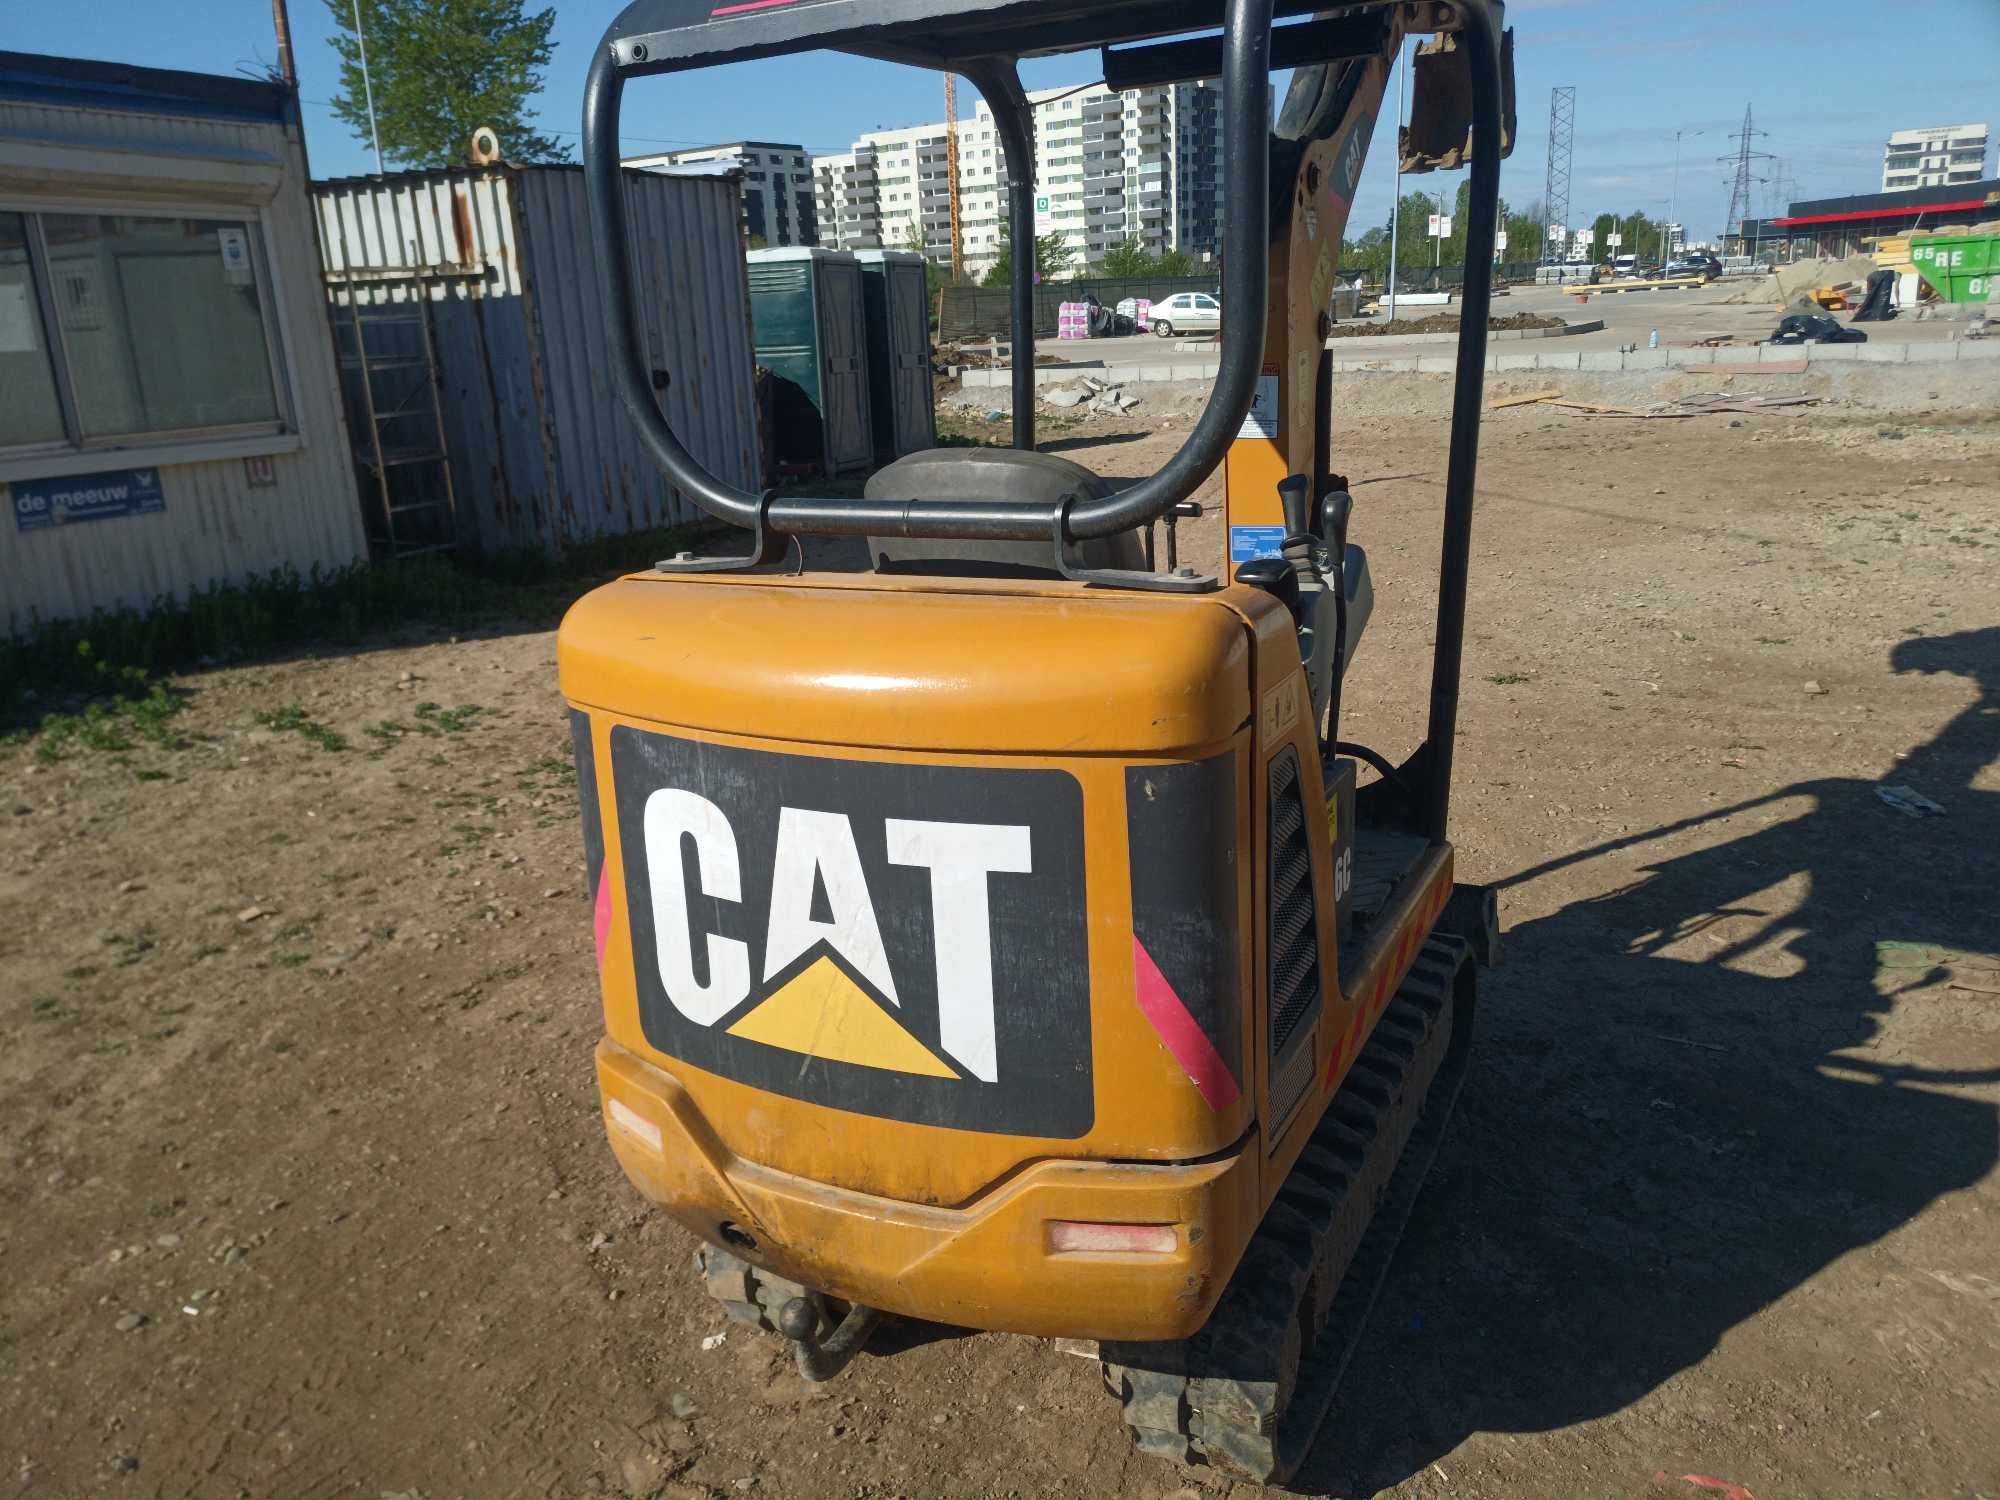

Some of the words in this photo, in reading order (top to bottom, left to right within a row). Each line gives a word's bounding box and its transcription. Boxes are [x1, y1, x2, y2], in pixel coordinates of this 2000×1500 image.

[17, 493, 46, 513] de
[51, 484, 129, 506] meeuw
[643, 787, 1033, 1084] CAT
